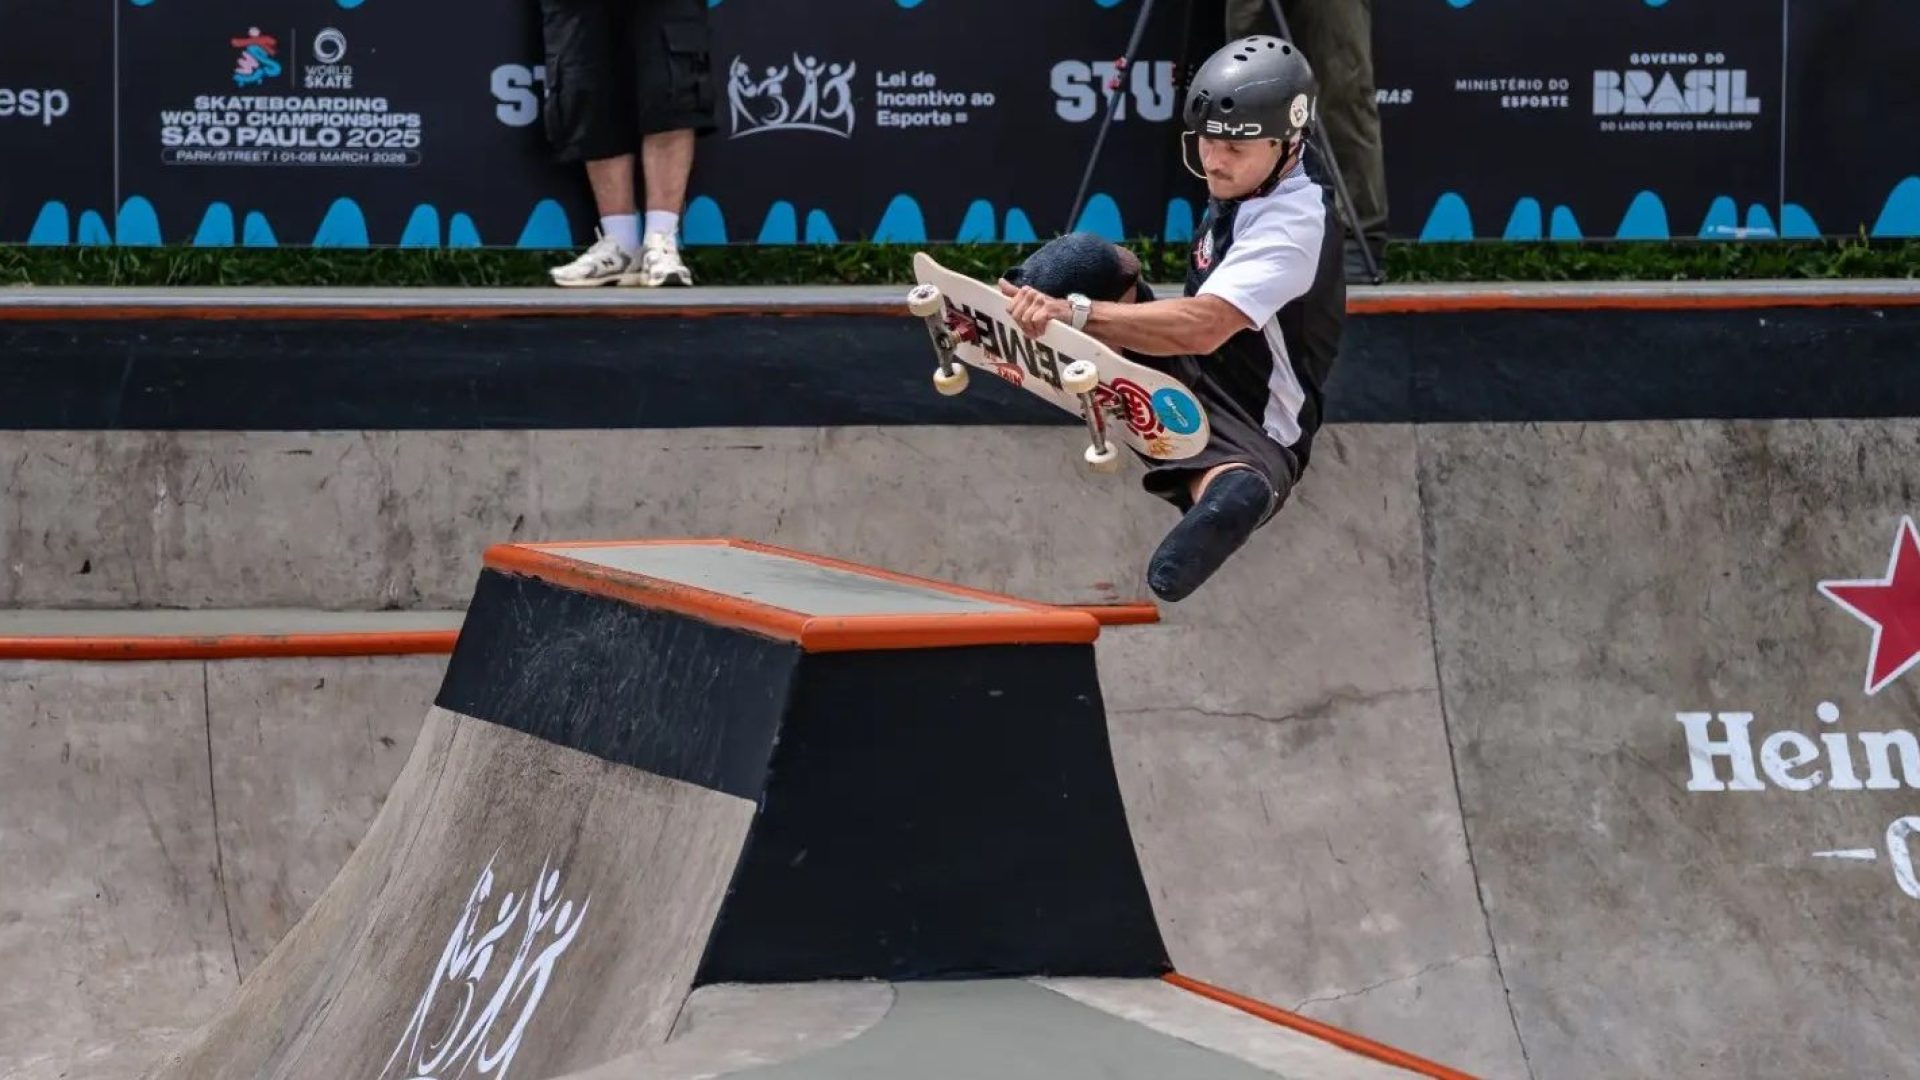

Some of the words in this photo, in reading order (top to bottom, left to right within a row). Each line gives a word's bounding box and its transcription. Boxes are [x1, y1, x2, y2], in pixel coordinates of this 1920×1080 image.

[1630, 53, 1698, 65] GOVERNO
[1704, 52, 1726, 65] DO
[304, 65, 353, 75] WORLD
[304, 75, 353, 89] SKATE
[876, 71, 906, 87] Lei
[911, 71, 936, 87] de
[1455, 78, 1543, 91] MINISTÉRIO
[1548, 79, 1569, 91] DO
[876, 90, 967, 106] Incentivo
[970, 92, 995, 106] ao
[1593, 69, 1761, 115] BRASIL
[195, 95, 388, 112] SKATEBOARDING
[1501, 95, 1569, 108] ESPORTE
[161, 110, 241, 127] WORLD
[246, 111, 421, 128] CHAMPIONSHIPS
[877, 109, 952, 128] Esporte
[1206, 119, 1262, 136] BYD
[161, 125, 231, 147] SÃO
[236, 127, 342, 148] PAULO
[345, 127, 421, 149] 2025
[320, 151, 369, 163] MARCH
[1675, 701, 1920, 793] Hein
